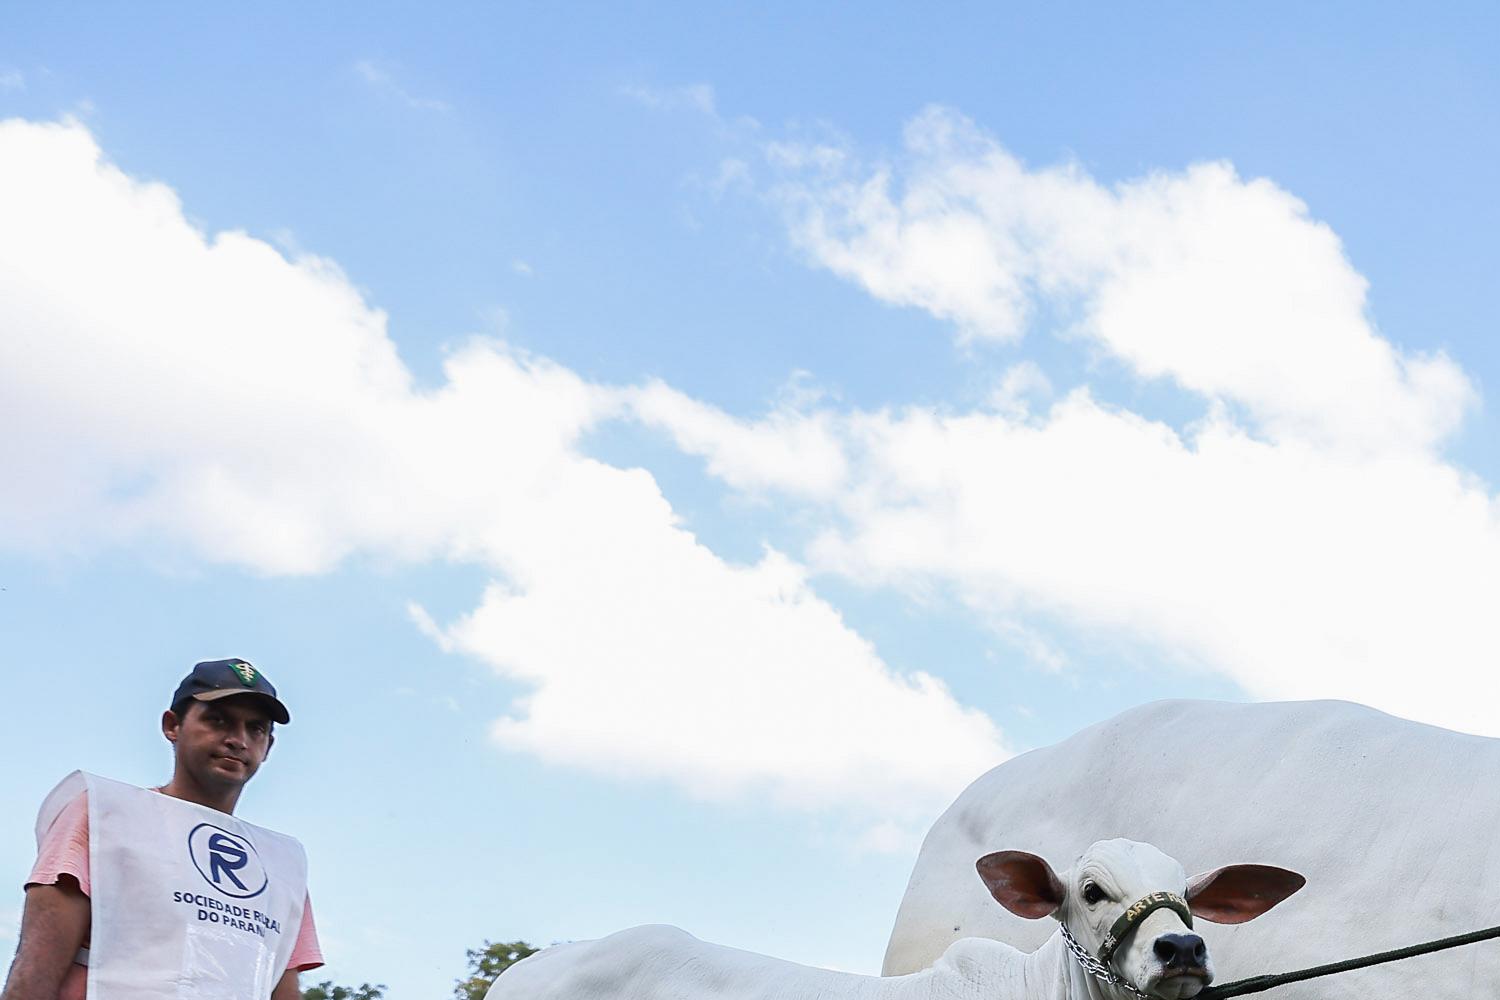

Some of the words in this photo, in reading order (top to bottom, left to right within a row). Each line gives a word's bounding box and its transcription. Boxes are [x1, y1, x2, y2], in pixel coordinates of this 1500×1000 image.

[173, 891, 251, 919] SOCIEDADE
[197, 908, 219, 923] DO
[223, 915, 265, 937] PARAN
